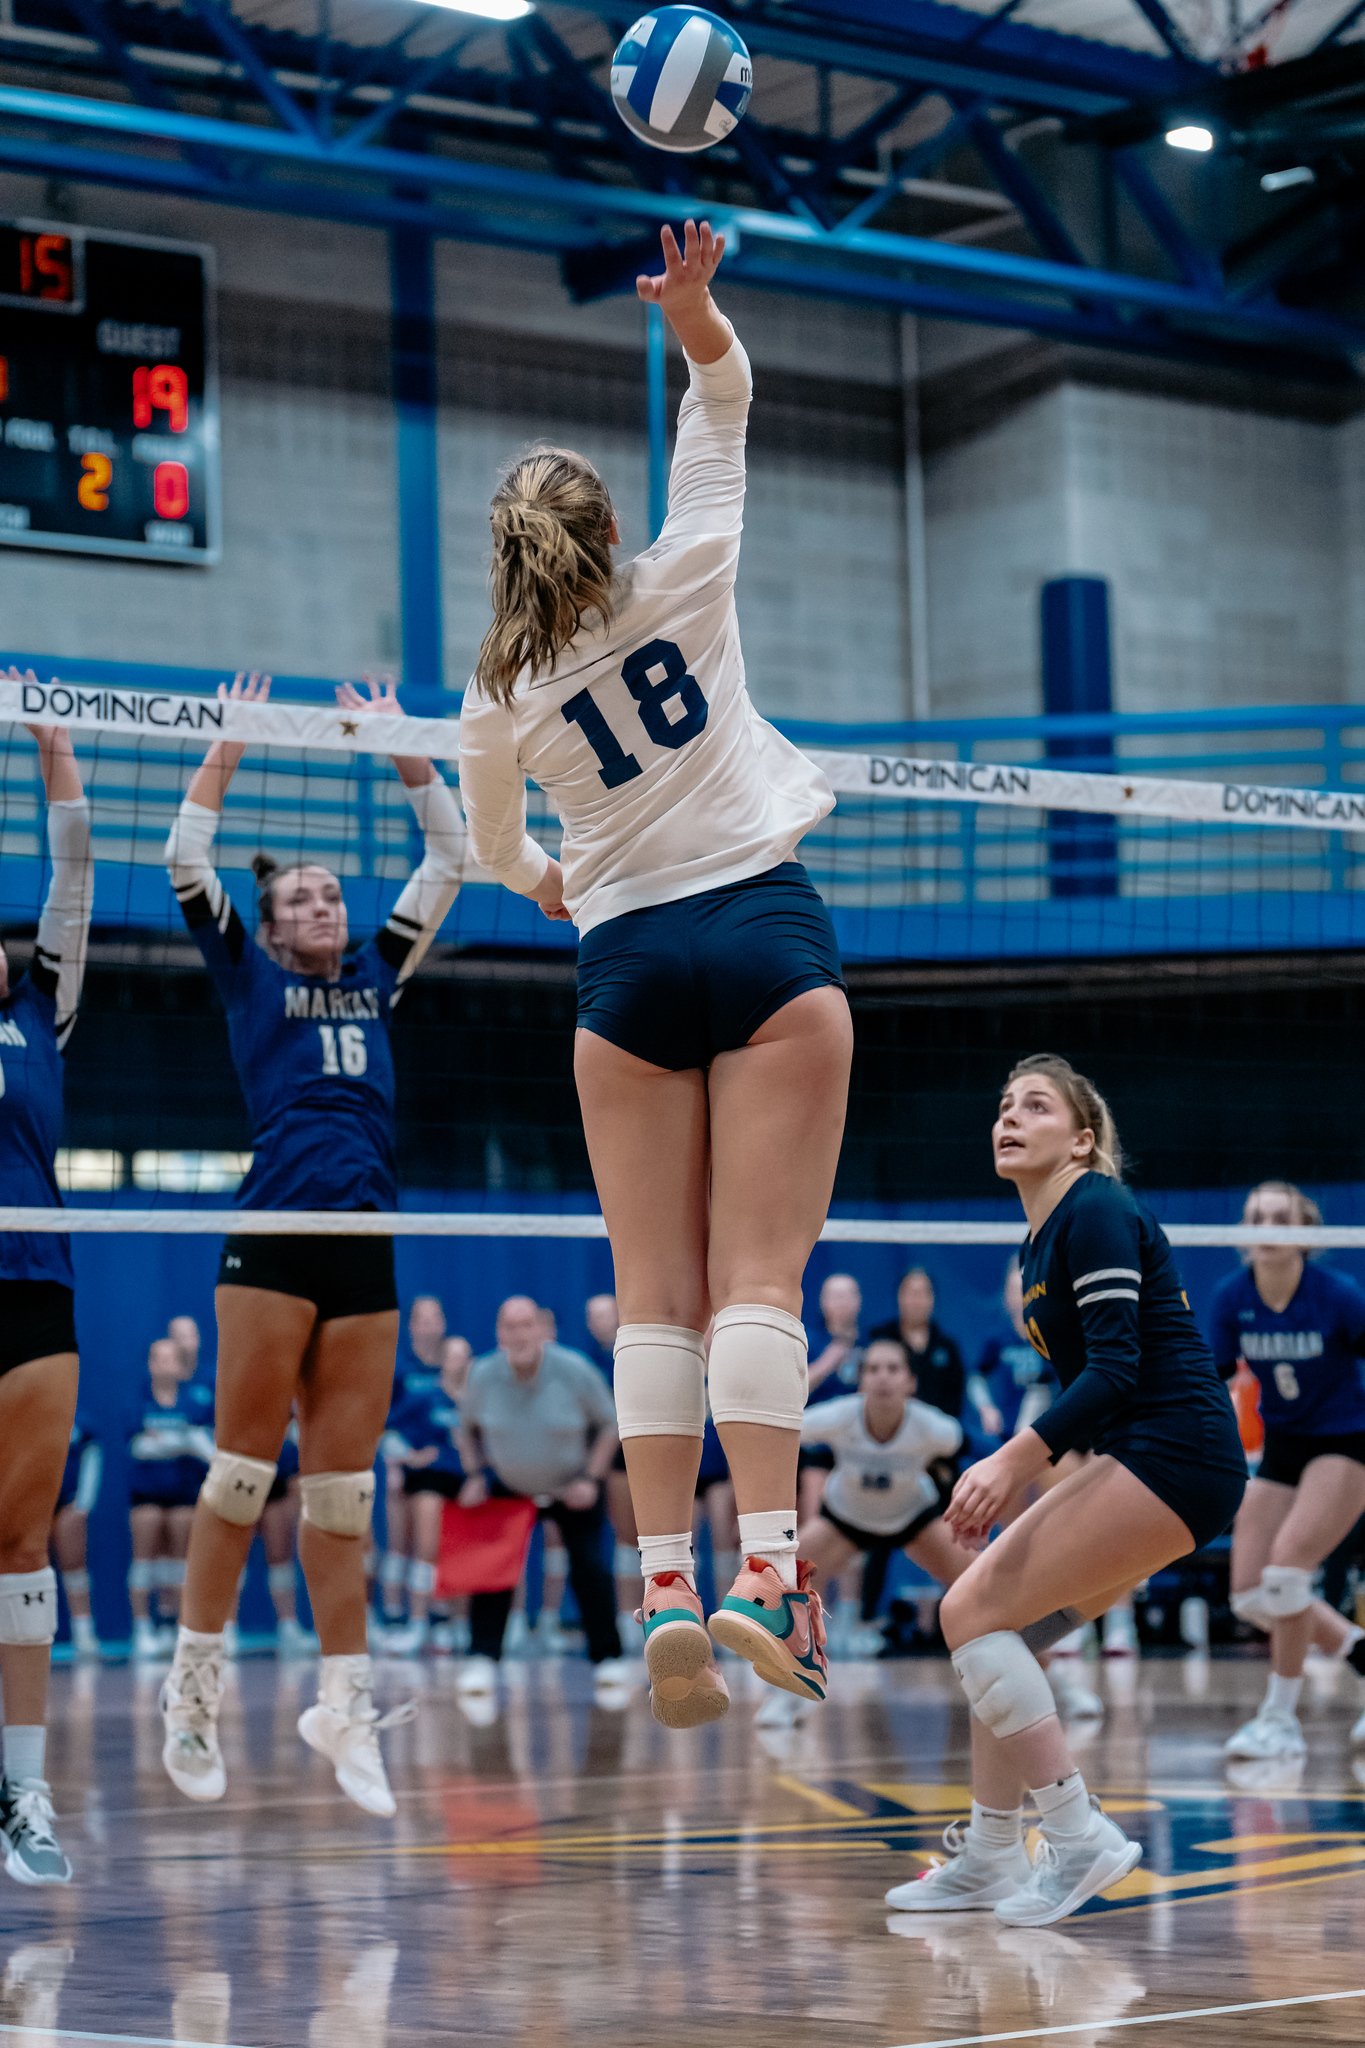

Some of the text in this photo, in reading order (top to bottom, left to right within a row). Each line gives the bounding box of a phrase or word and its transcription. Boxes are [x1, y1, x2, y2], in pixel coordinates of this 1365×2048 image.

[20, 234, 72, 301] 15
[133, 364, 188, 433] 19
[77, 452, 112, 511] 2
[154, 461, 189, 519] 0
[22, 684, 223, 729] DOMINICAN
[561, 638, 709, 790] 18
[870, 758, 1030, 793] DOMINICAN
[1223, 784, 1365, 820] DOMINICAN
[318, 1024, 367, 1076] 16
